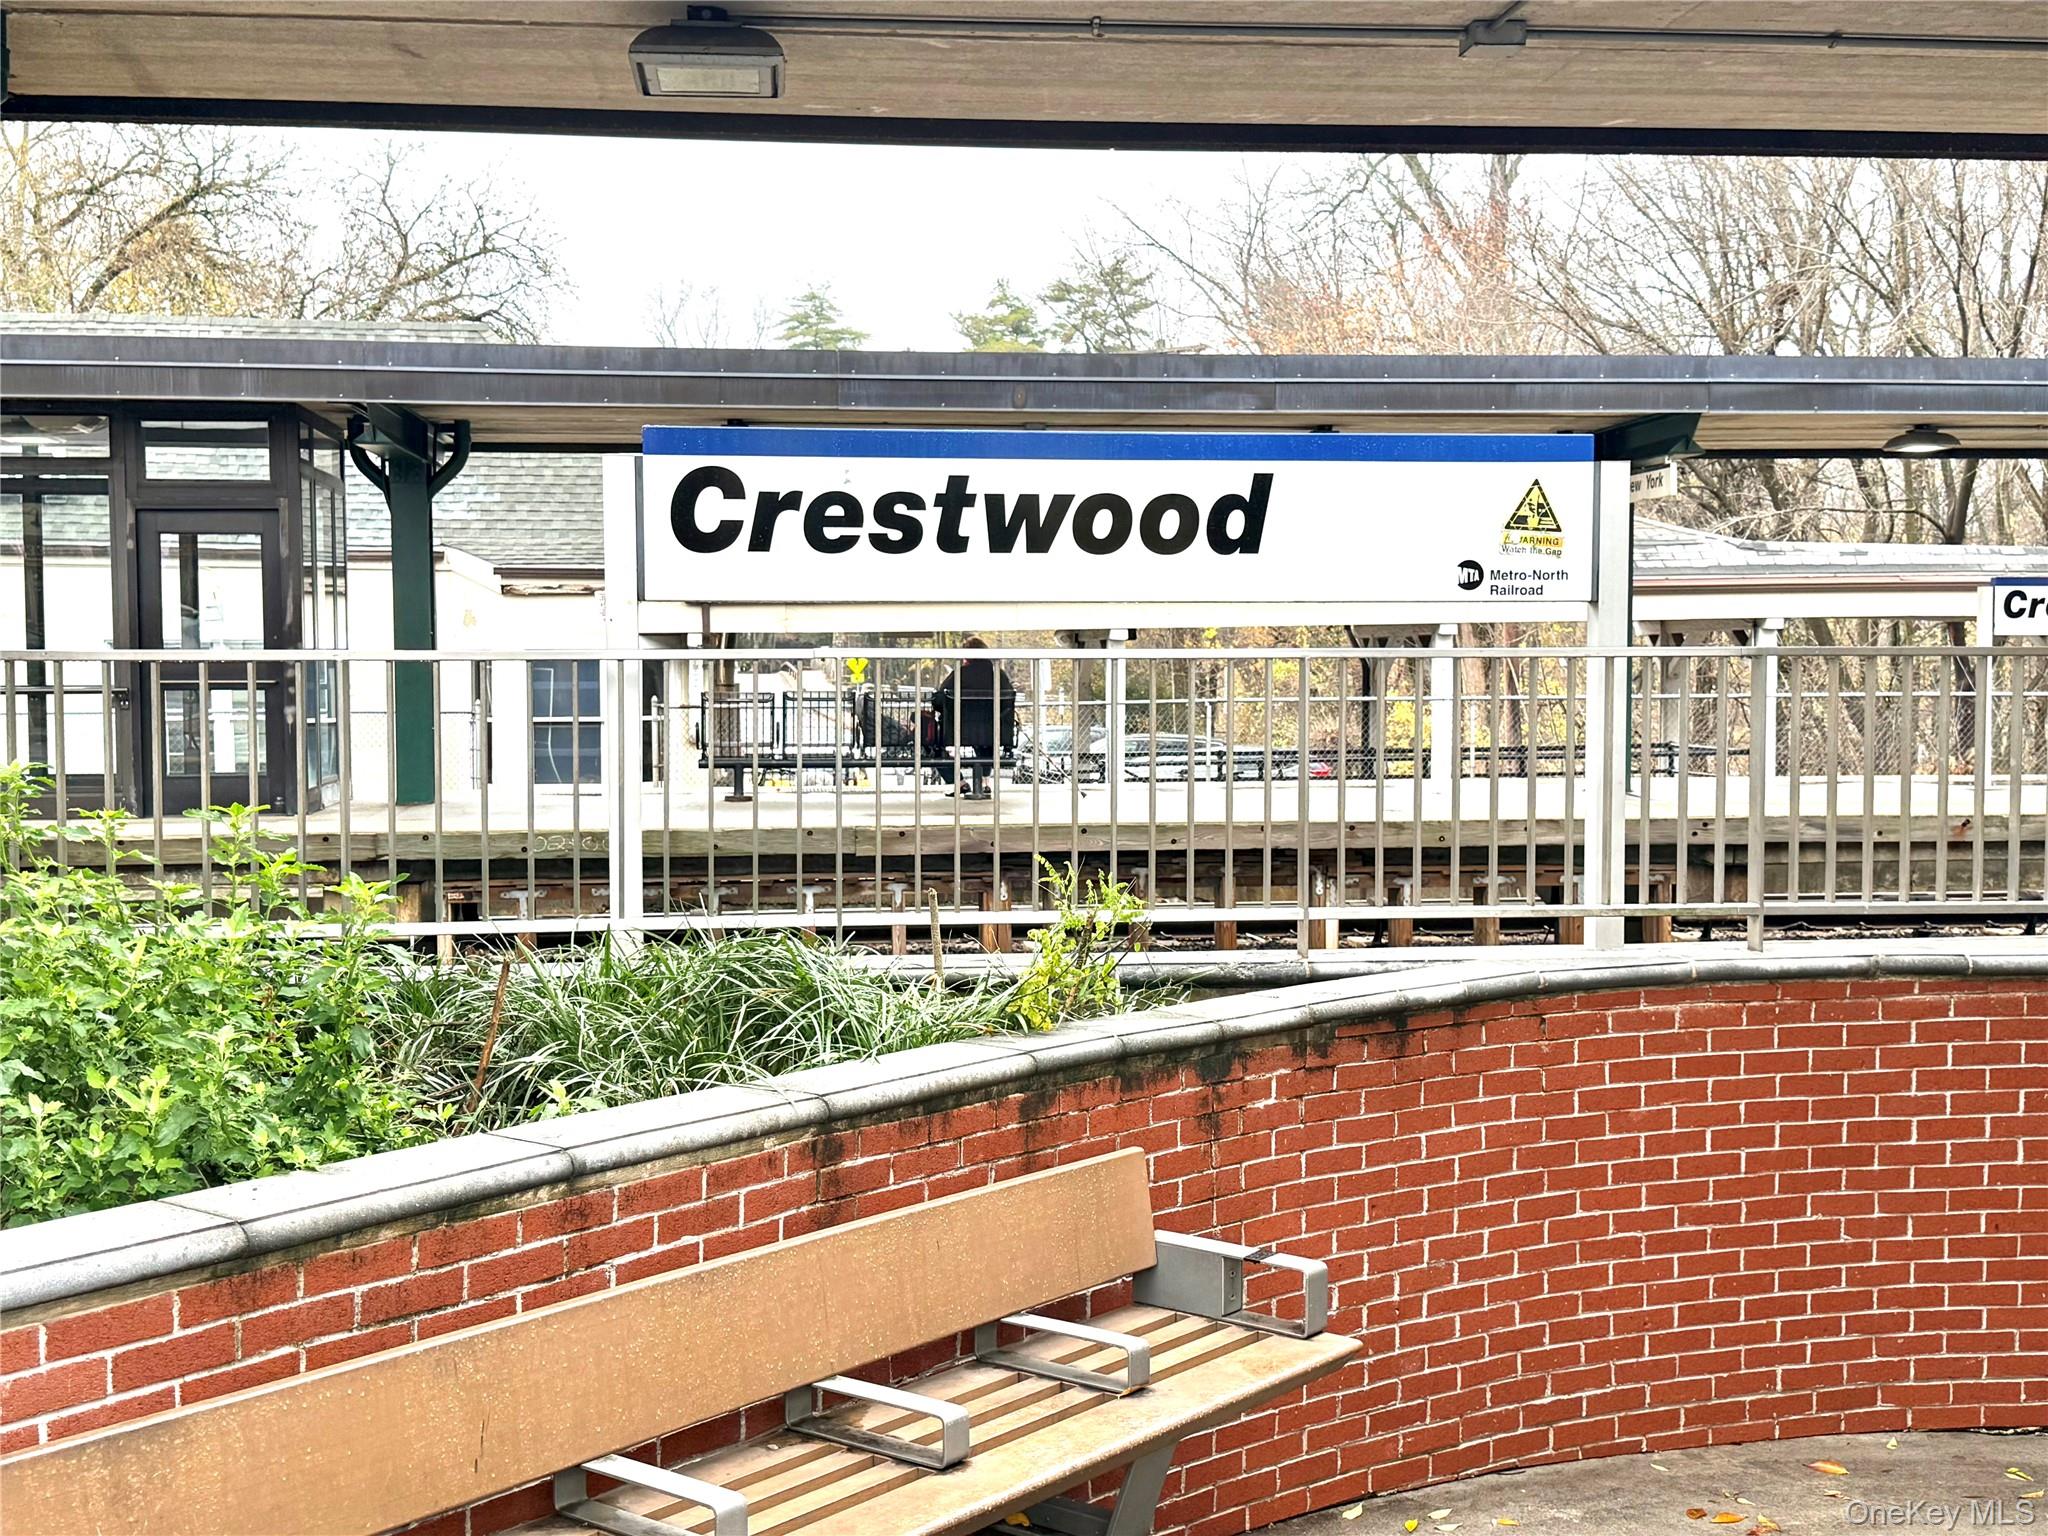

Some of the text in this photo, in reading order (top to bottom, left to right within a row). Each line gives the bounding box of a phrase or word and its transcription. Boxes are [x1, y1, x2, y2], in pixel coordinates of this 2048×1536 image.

[1630, 472, 1664, 493] ew York
[670, 465, 1274, 556] Crestwood
[1501, 544, 1563, 559] Watch the Gap
[1458, 565, 1482, 586] MTA
[1490, 569, 1569, 581] Metro-North
[1490, 584, 1544, 596] Railroad
[2003, 589, 2048, 619] Cr
